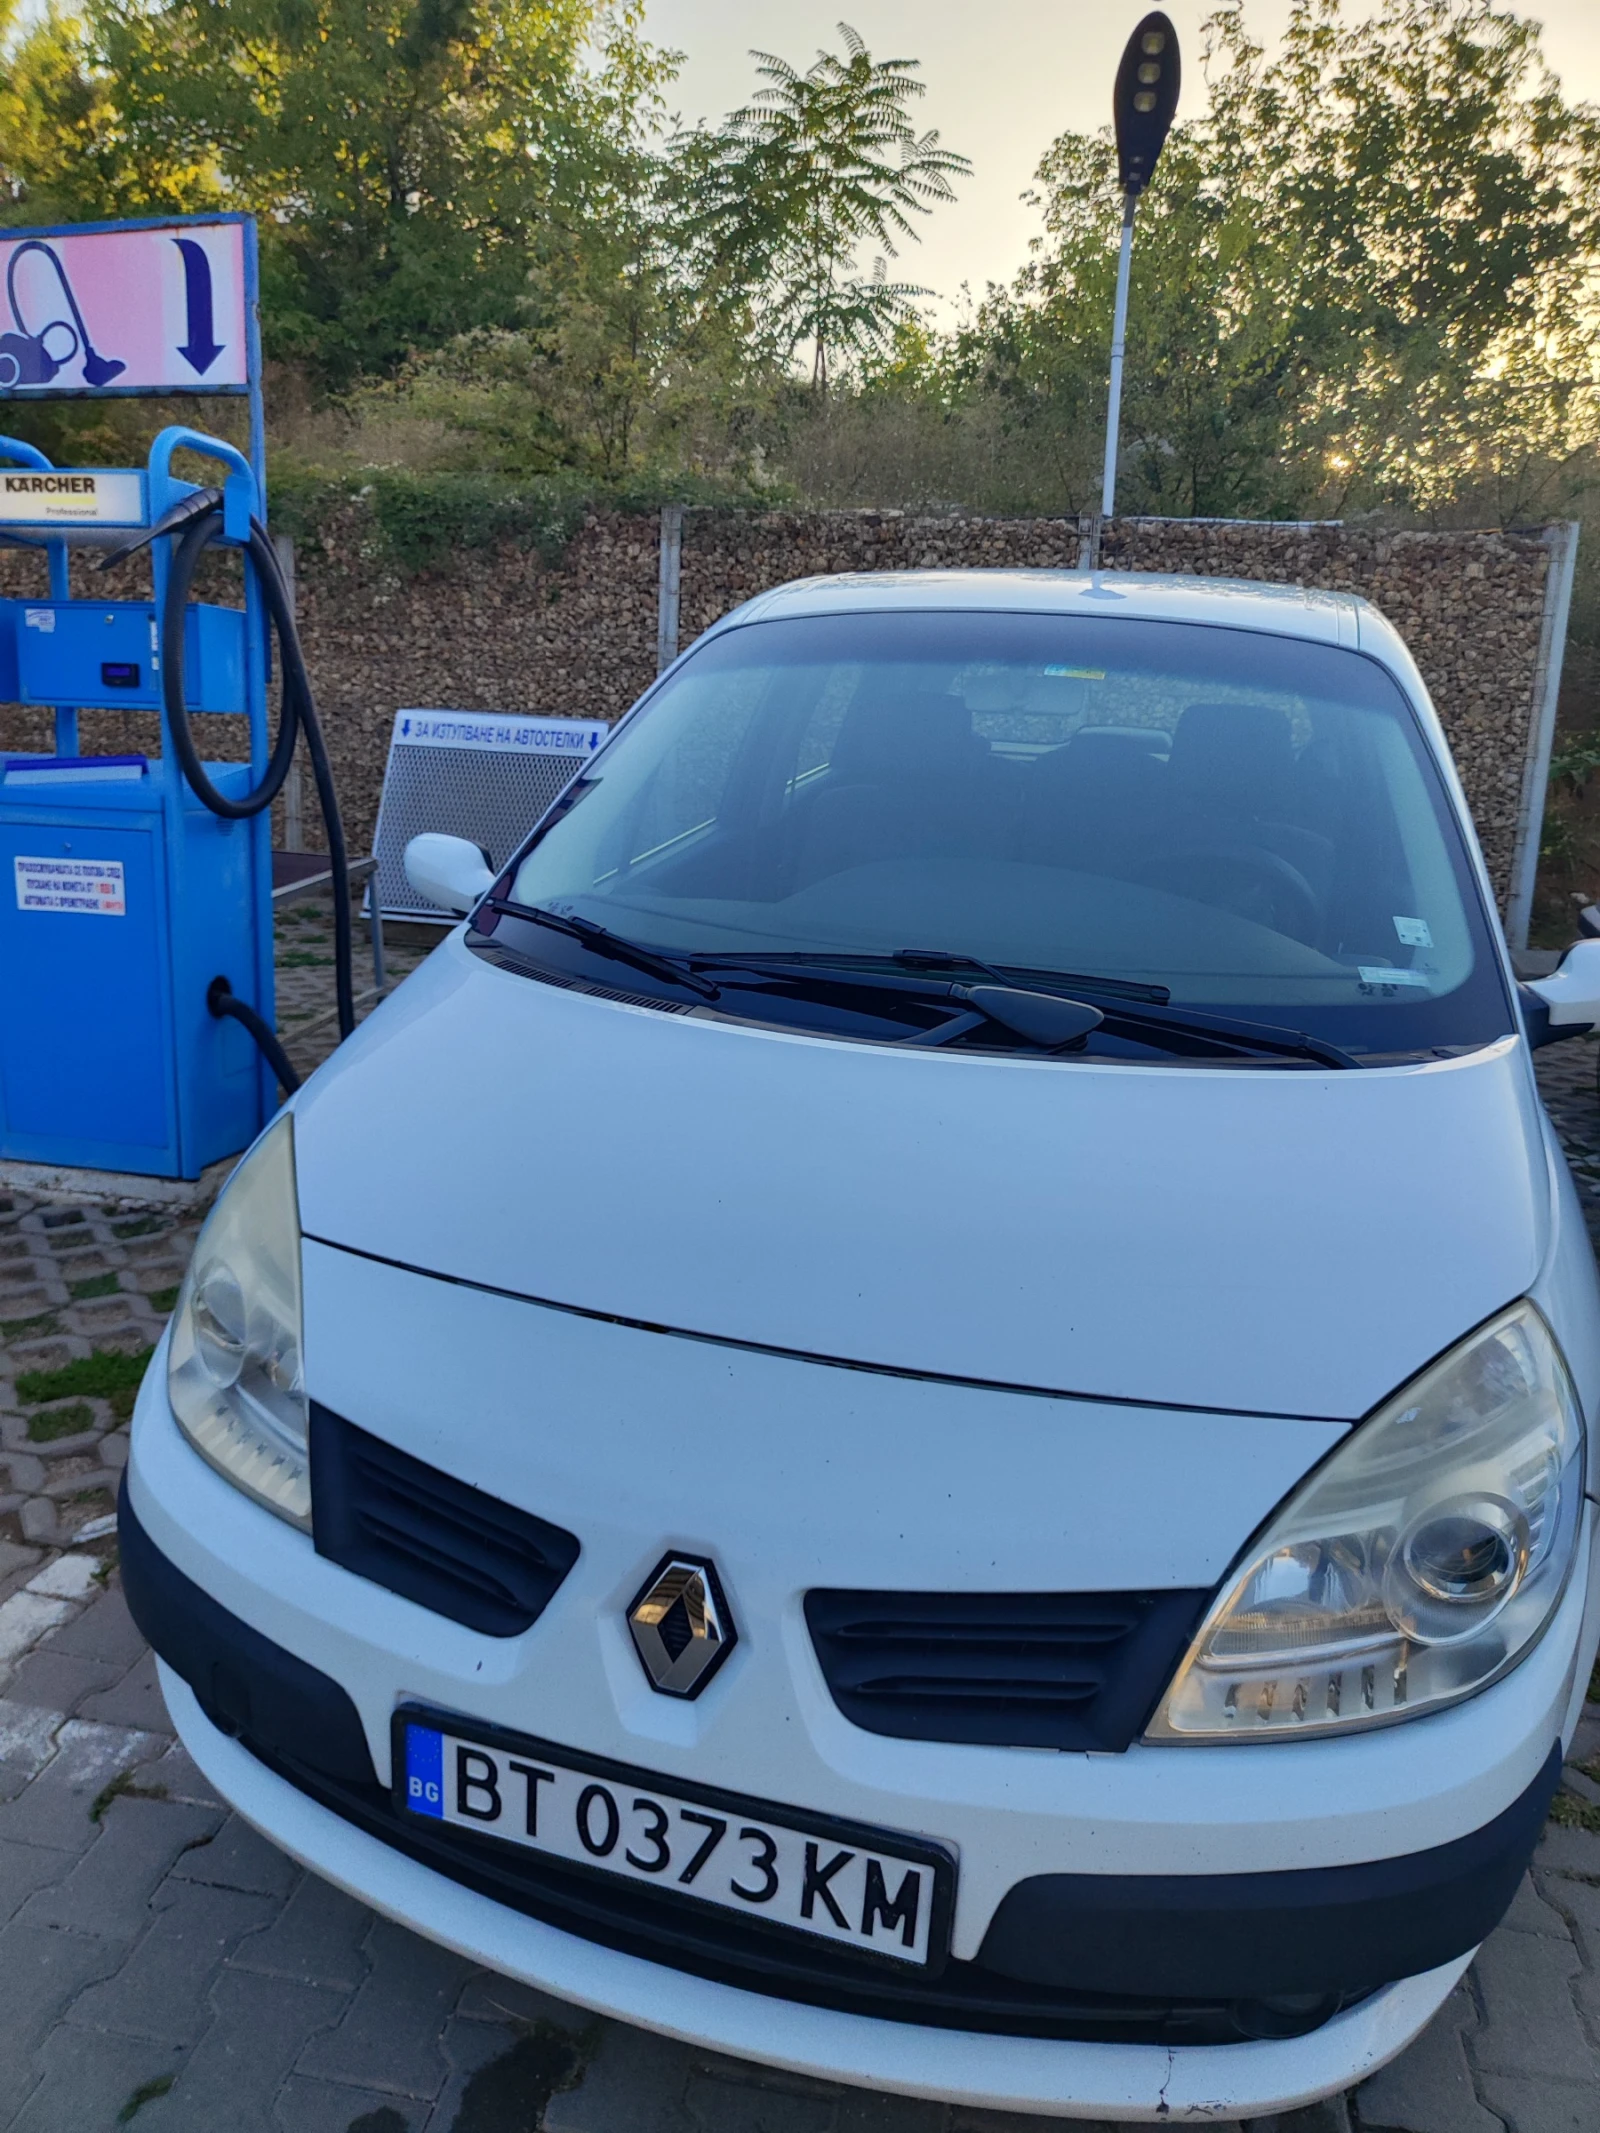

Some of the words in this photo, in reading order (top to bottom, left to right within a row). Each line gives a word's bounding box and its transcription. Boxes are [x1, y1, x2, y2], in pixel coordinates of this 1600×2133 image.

[5, 477, 95, 493] KÄRCHER
[46, 507, 98, 516] Professional
[415, 722, 429, 738] ЗА
[432, 723, 495, 744] ИЗТУПВАНЕ
[497, 728, 511, 742] НА
[514, 729, 585, 749] АВТОСТЕЛКИ
[408, 1776, 440, 1803] BG
[456, 1745, 555, 1837] BT
[576, 1784, 779, 1903] 0373
[799, 1842, 921, 1949] KM
